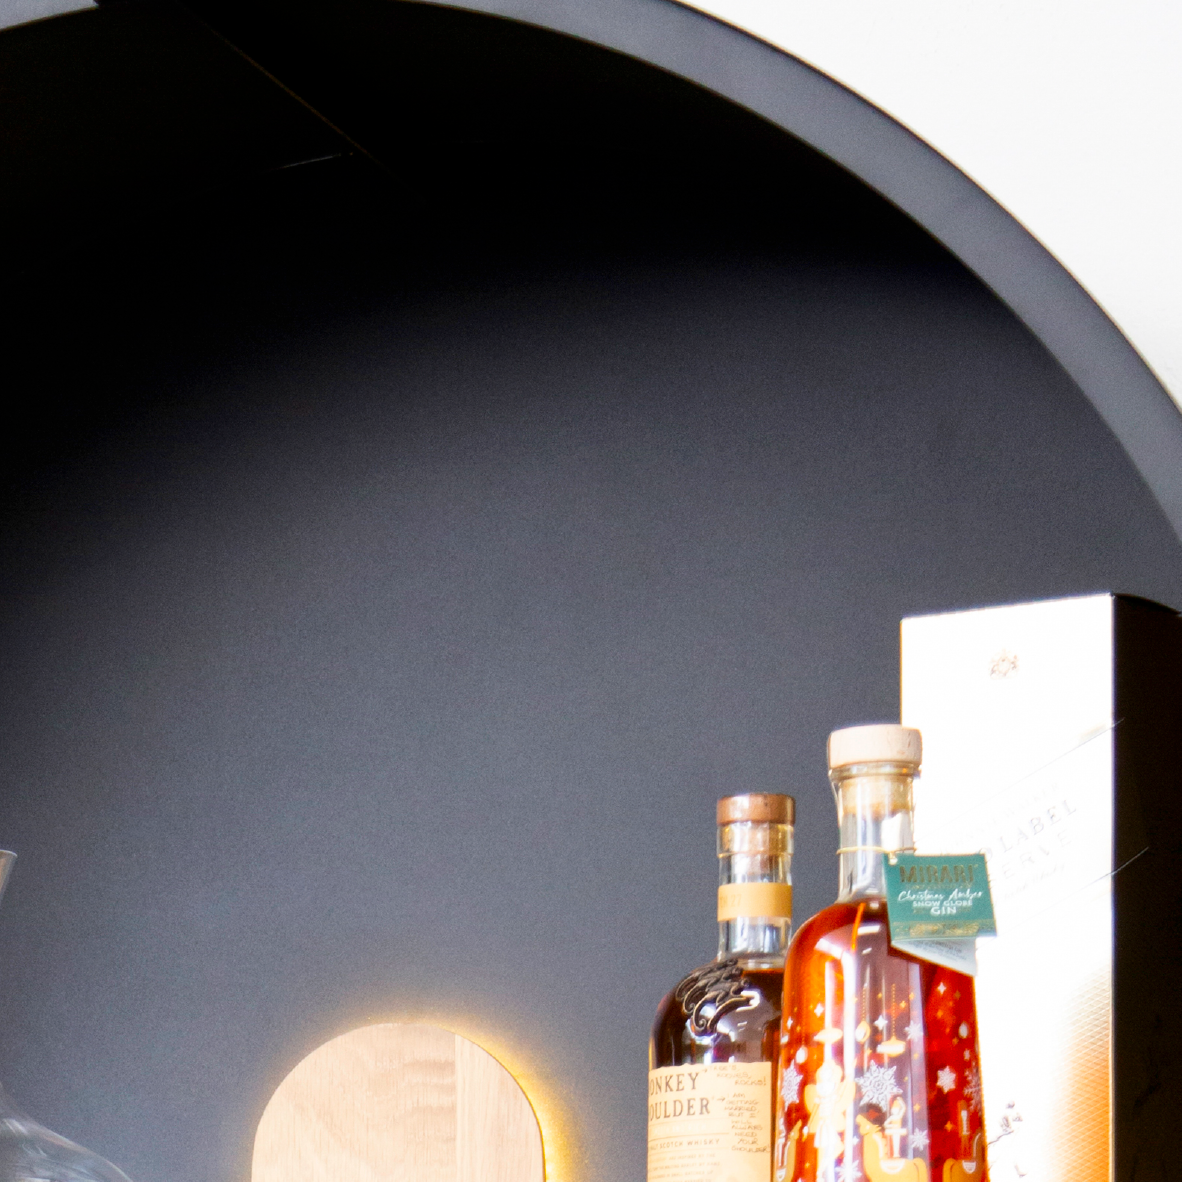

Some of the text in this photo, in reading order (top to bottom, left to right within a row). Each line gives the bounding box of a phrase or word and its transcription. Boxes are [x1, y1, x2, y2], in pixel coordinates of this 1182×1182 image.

[999, 799, 1077, 853] LABEL
[899, 865, 974, 883] MIRARI
[930, 906, 957, 916] GIN
[650, 1072, 700, 1096] ONKEY
[650, 1097, 710, 1121] OULDER
[659, 1141, 684, 1150] SCOTCH
[687, 1138, 720, 1147] WHISKY
